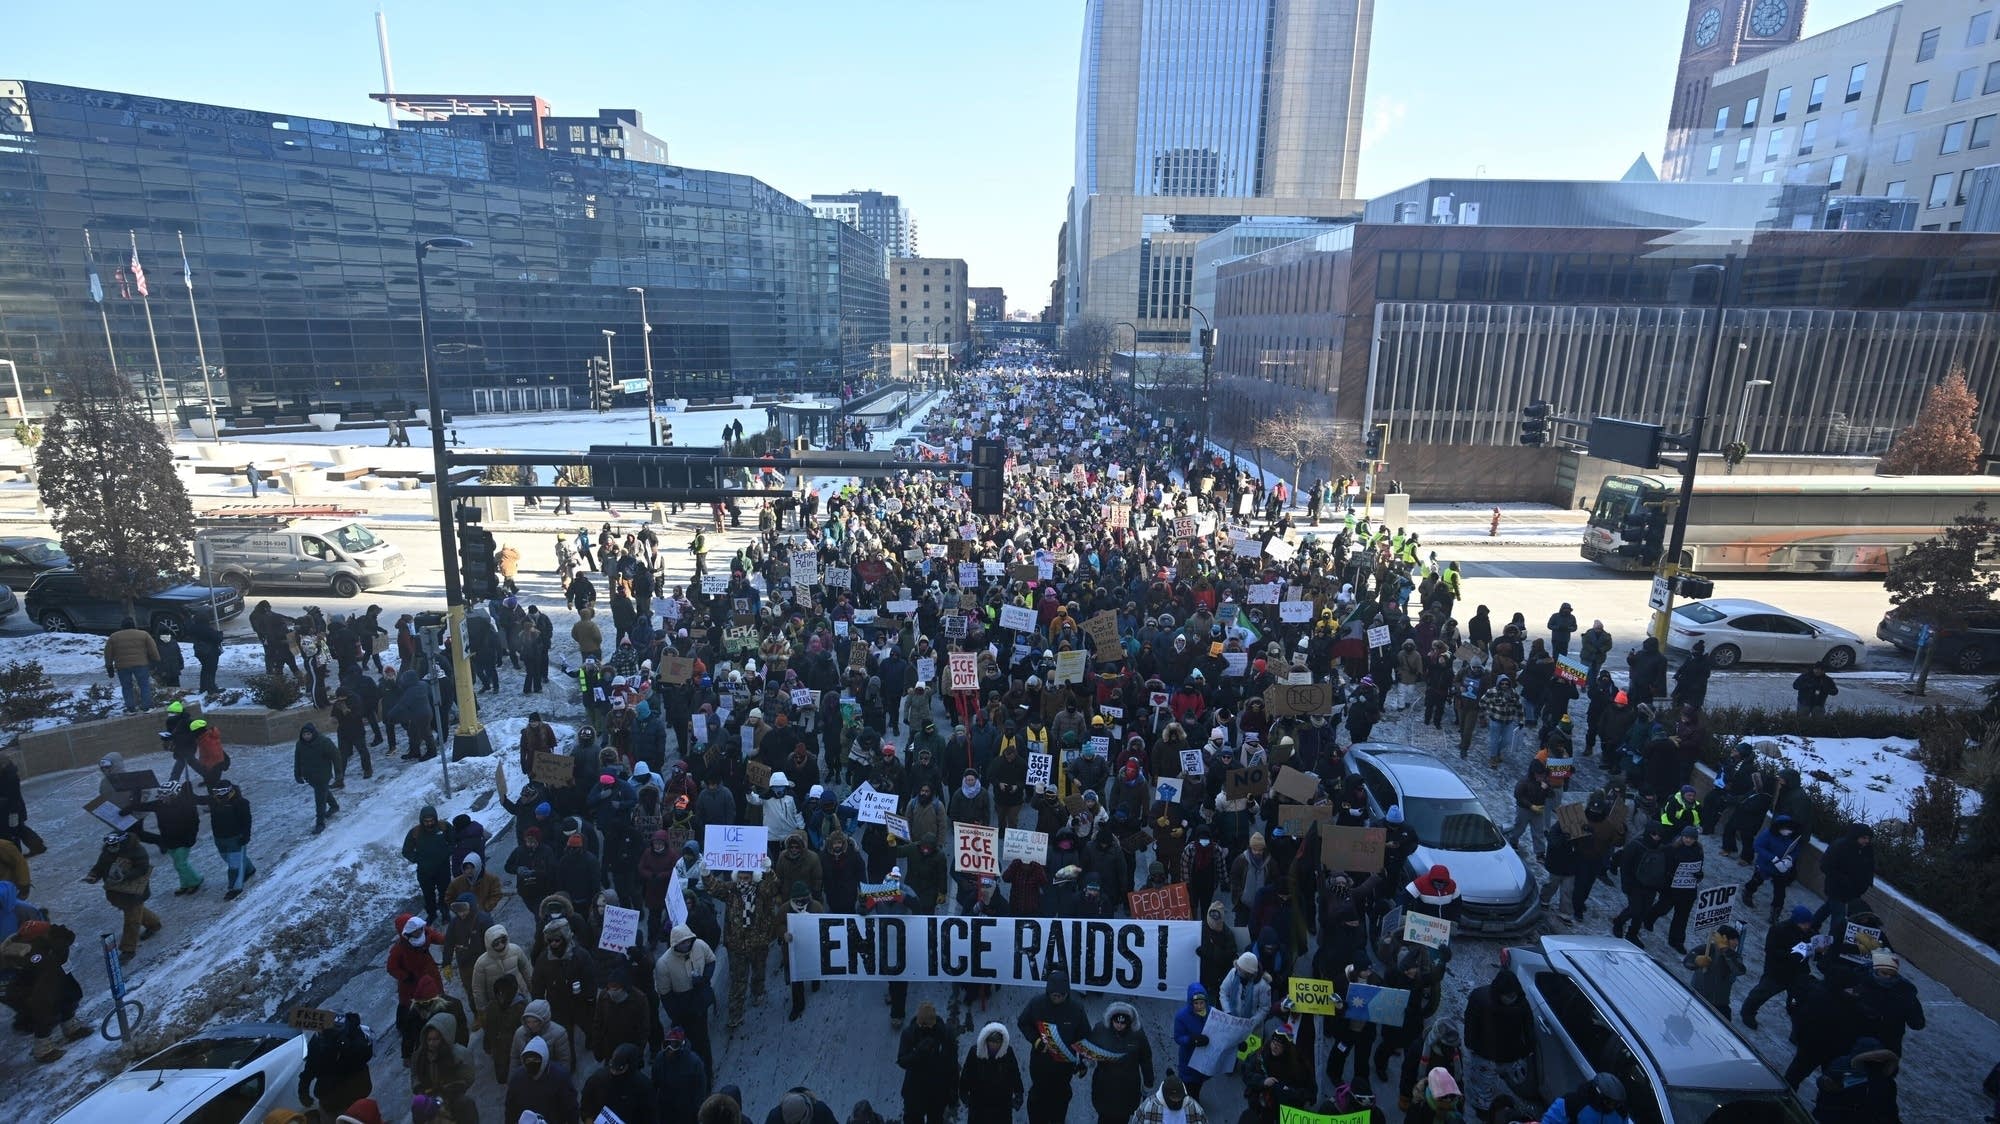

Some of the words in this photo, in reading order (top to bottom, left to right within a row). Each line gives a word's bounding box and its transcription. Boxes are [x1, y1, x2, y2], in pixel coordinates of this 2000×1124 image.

[1176, 520, 1191, 529] ICE
[1655, 578, 1668, 590] ONE
[1654, 587, 1667, 598] WAY
[952, 660, 975, 673] ICE
[953, 673, 976, 686] OUT!
[1032, 754, 1049, 765] ICE
[1031, 762, 1049, 772] OUT
[1039, 769, 1049, 778] OF
[1234, 769, 1263, 786] NO
[865, 793, 878, 803] No
[724, 827, 744, 842] ICE
[959, 836, 992, 856] ICE
[959, 852, 995, 872] OUT!
[1131, 886, 1188, 915] PEOPLE
[1698, 887, 1737, 909] STOP
[1695, 910, 1707, 921] ICE
[1708, 906, 1732, 918] TERROR
[1863, 928, 1879, 936] OUT
[820, 918, 906, 976] END
[927, 918, 998, 978] ICE
[1013, 920, 1169, 992] RAIDS!
[1295, 982, 1311, 992] ICE
[1312, 984, 1329, 993] OUT
[1295, 992, 1330, 1005] NOW!
[297, 1009, 326, 1022] FREE
